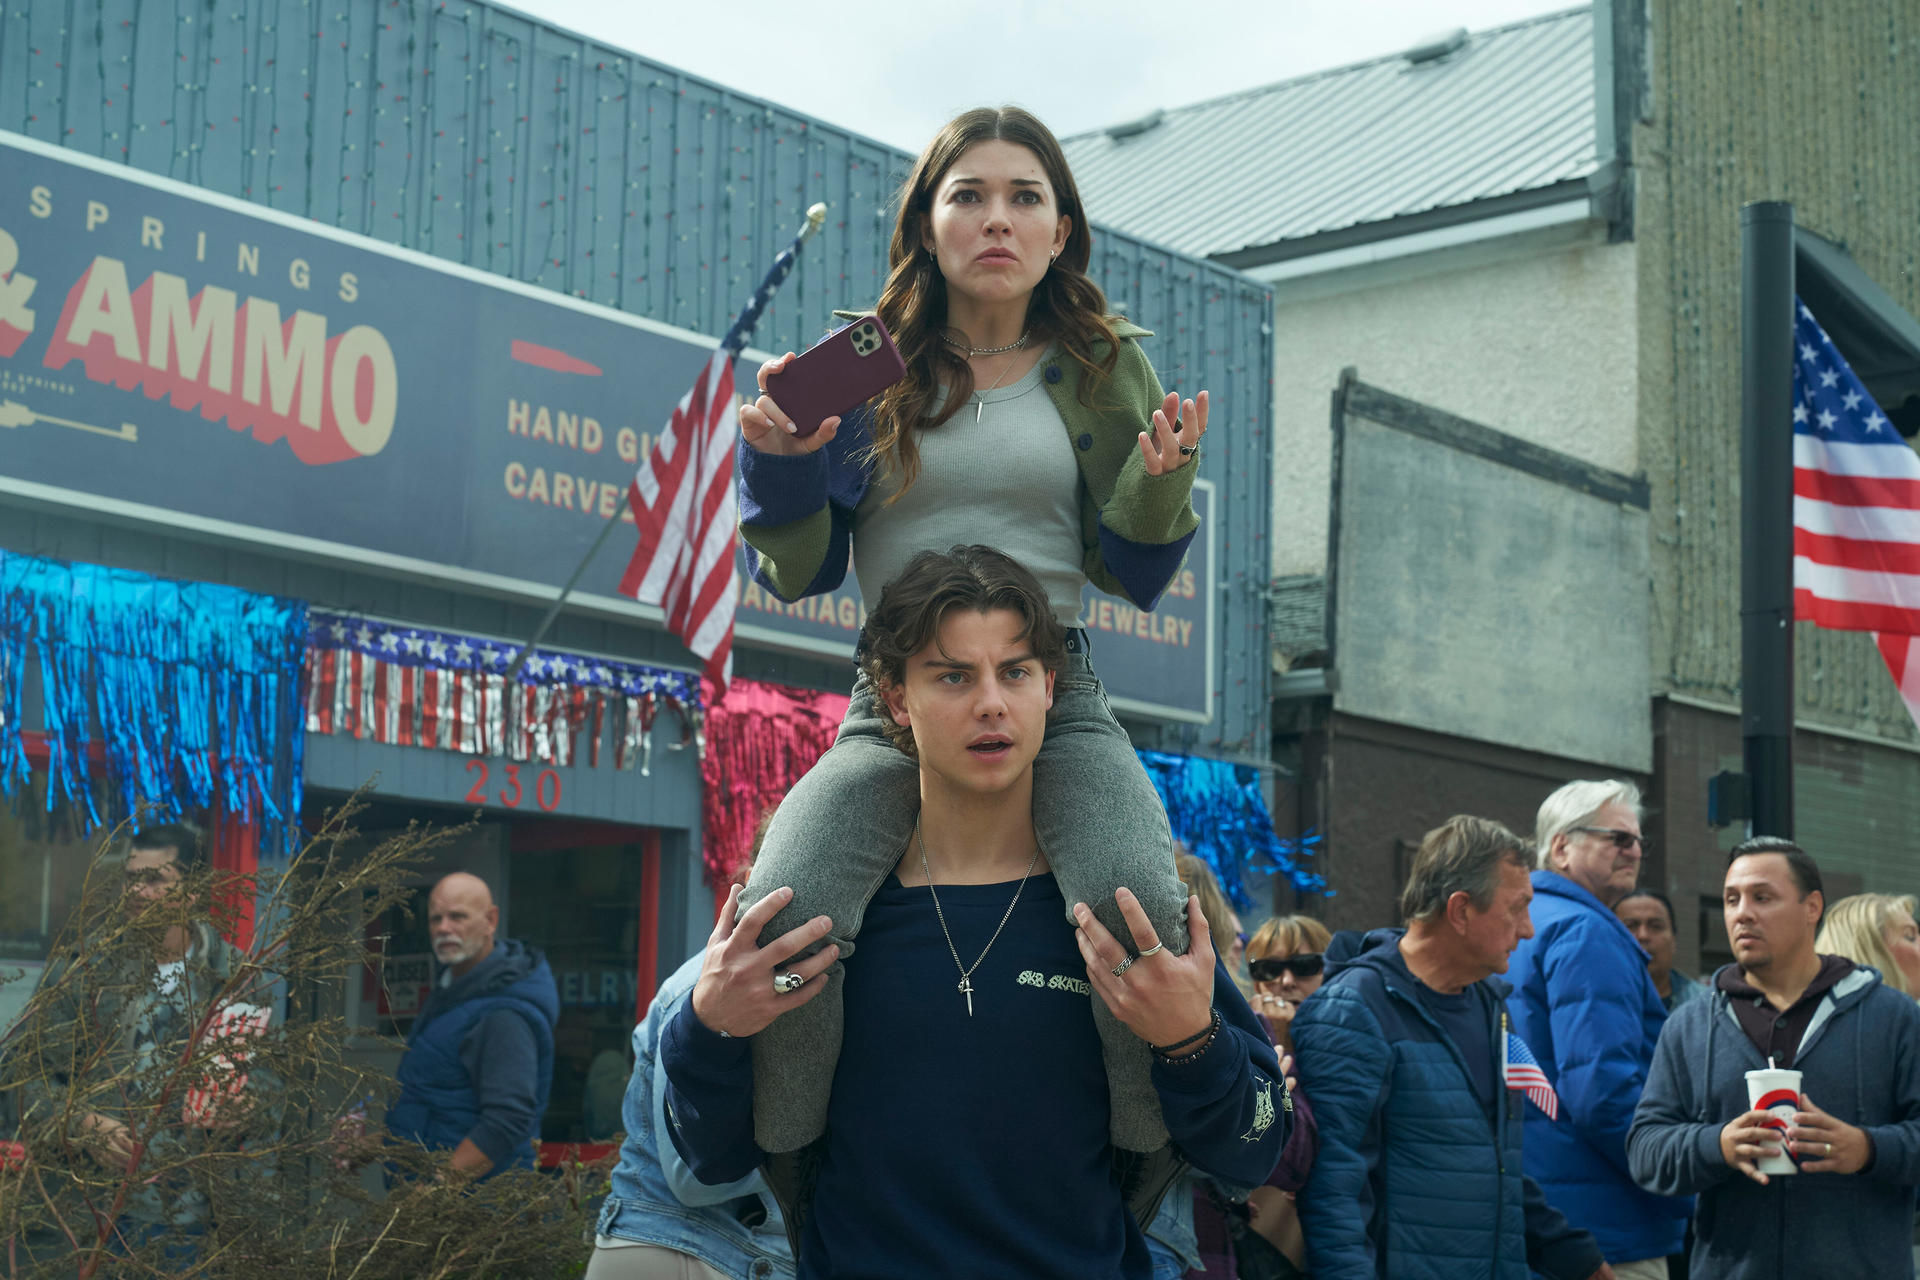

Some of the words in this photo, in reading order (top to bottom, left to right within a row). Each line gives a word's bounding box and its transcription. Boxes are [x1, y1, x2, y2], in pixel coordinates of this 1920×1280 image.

[29, 185, 360, 303] SPRINGS
[42, 256, 398, 466] AMMO
[508, 399, 603, 454] HAND
[1086, 597, 1193, 648] JEWELRY
[465, 759, 562, 812] 230
[560, 970, 638, 1004] ELRY
[1047, 974, 1091, 996] SKATES
